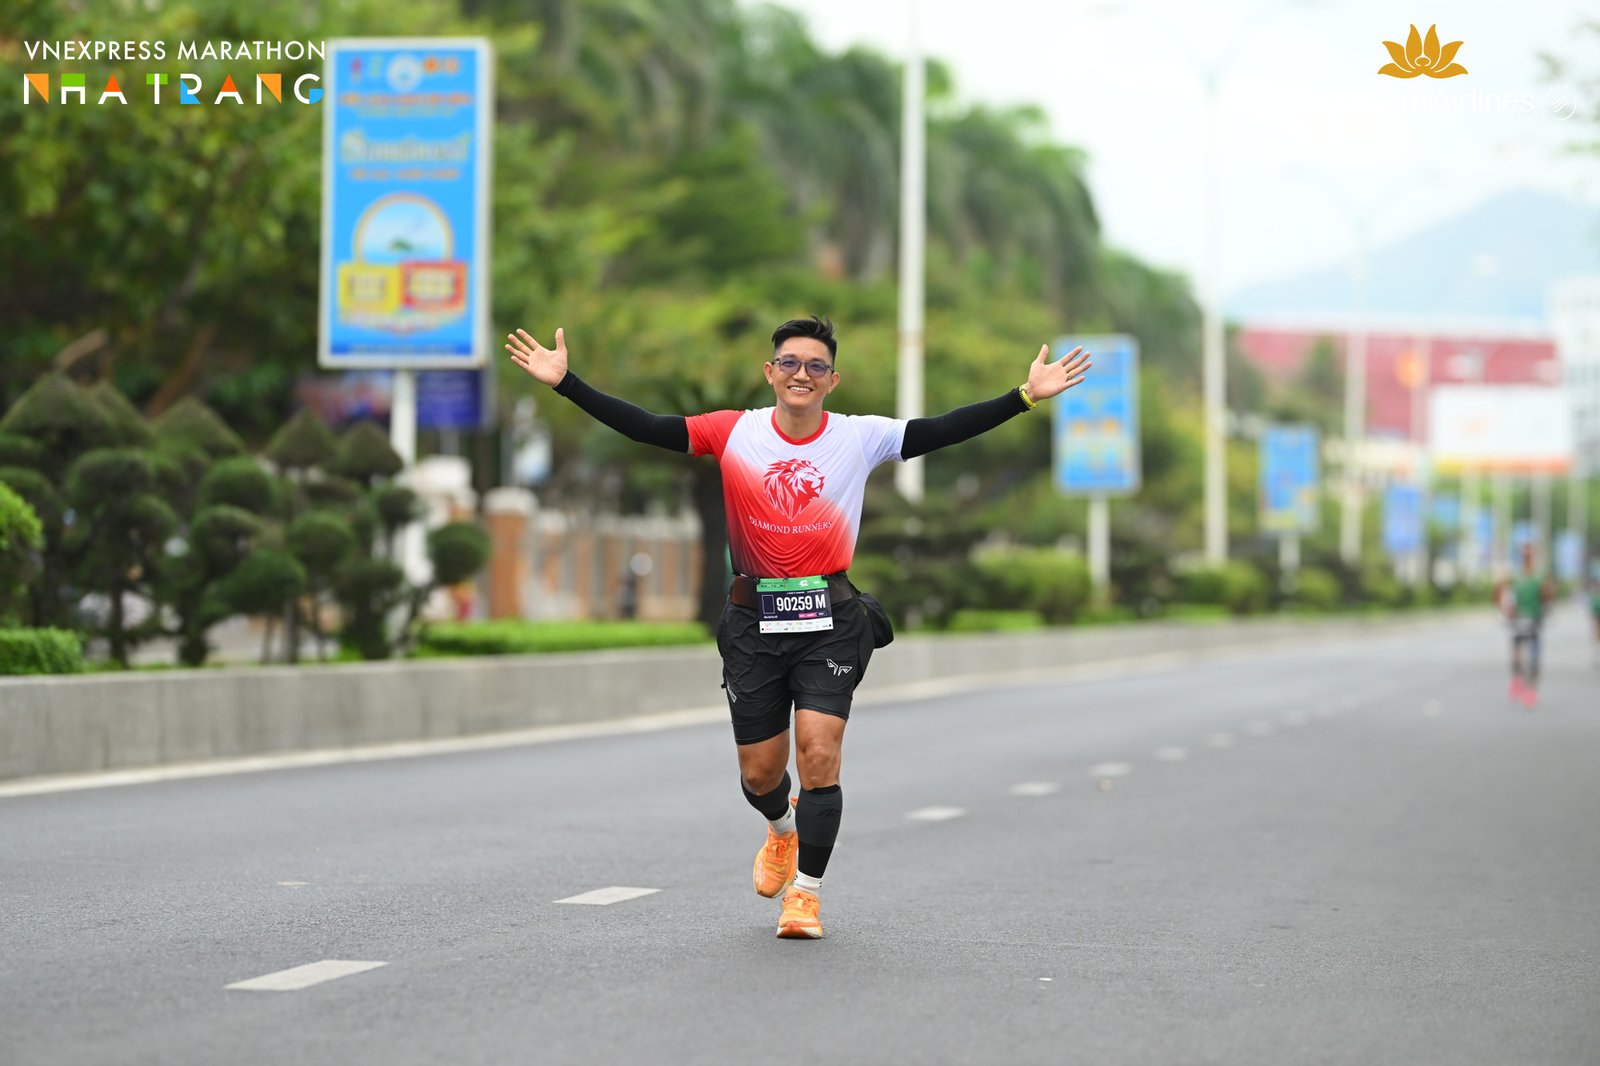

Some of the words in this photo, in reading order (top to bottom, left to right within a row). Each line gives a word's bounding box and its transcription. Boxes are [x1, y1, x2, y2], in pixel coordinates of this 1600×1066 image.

[792, 520, 833, 534] RUNNERS
[776, 595, 813, 612] 90259
[815, 593, 827, 610] M
